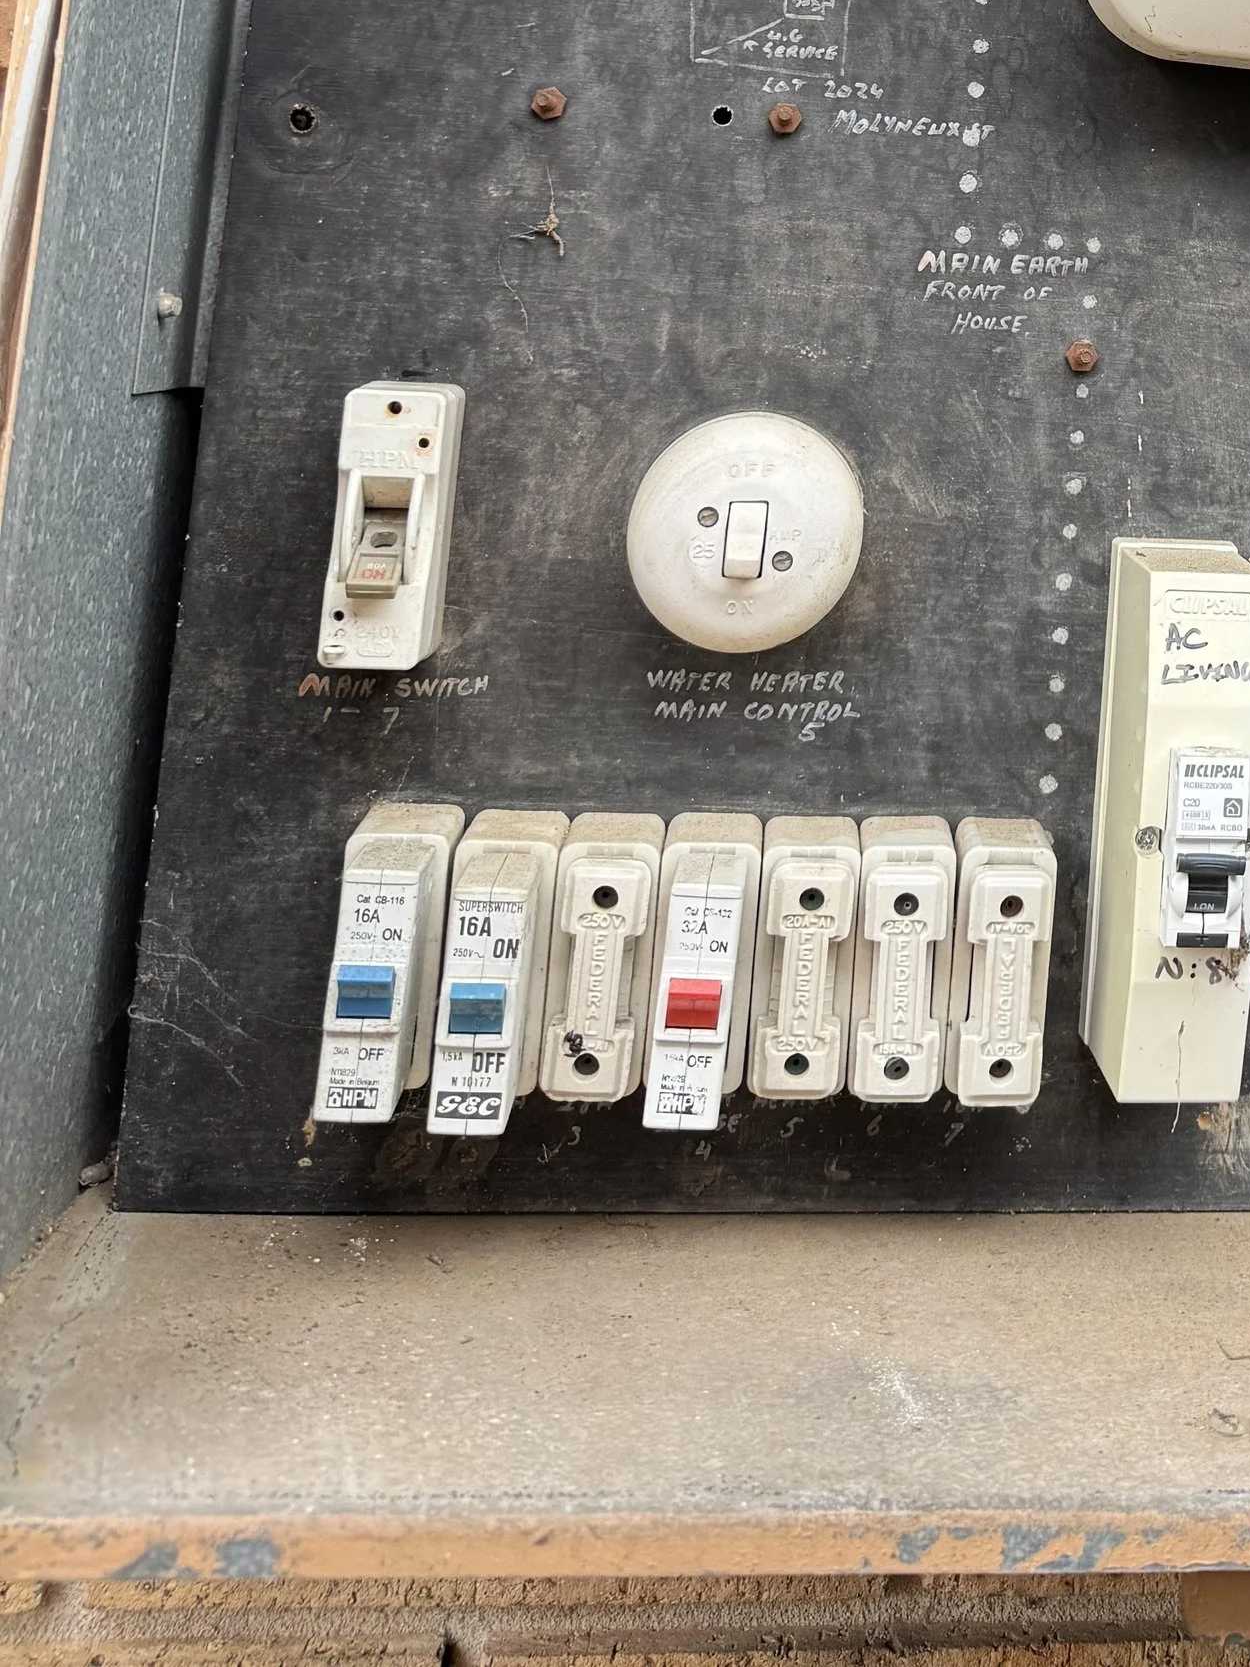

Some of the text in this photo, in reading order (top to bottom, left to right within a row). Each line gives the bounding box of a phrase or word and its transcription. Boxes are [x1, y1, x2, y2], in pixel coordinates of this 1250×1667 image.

[763, 41, 838, 60] SERVICE
[762, 77, 884, 99] LOT 2024
[827, 109, 960, 136] MOLYNEUX
[917, 249, 1089, 277] MAIN EARTH
[922, 280, 1053, 302] FRONT OF
[727, 463, 776, 478] OFF
[692, 543, 715, 559] 25
[361, 569, 386, 580] ON
[726, 600, 754, 615] ON
[1170, 596, 1248, 616] CLIPSAL
[1165, 622, 1208, 651] AC
[298, 673, 489, 699] MAIN SWITCH
[647, 668, 732, 693] WATER
[383, 706, 400, 735] 7
[654, 698, 860, 723] MAIN CONTROL
[798, 721, 825, 742] 5
[1197, 764, 1244, 779] CLIPSAL
[1183, 798, 1200, 807] C20
[1220, 824, 1243, 832] RCBO
[356, 894, 405, 905] Cat CB-116
[459, 900, 523, 914] SUPERSWITCH
[354, 908, 380, 923] 16A
[382, 928, 402, 941] ON
[459, 916, 492, 937] 16A
[681, 920, 708, 935] 32A
[492, 938, 520, 959] ON
[709, 940, 728, 953] ON
[584, 931, 609, 1035] FEDERAL
[792, 931, 814, 1035] FEDERAL
[892, 938, 911, 1040] FEDERAL
[997, 937, 1017, 1039] FEDERAL
[333, 1046, 385, 1061] 3kA OFF
[472, 1051, 506, 1073] OFF
[687, 1055, 712, 1068] OFF
[329, 1077, 347, 1085] Made
[451, 1076, 492, 1087] N 10177
[342, 1088, 377, 1108] HPM
[436, 1095, 501, 1116] GEC
